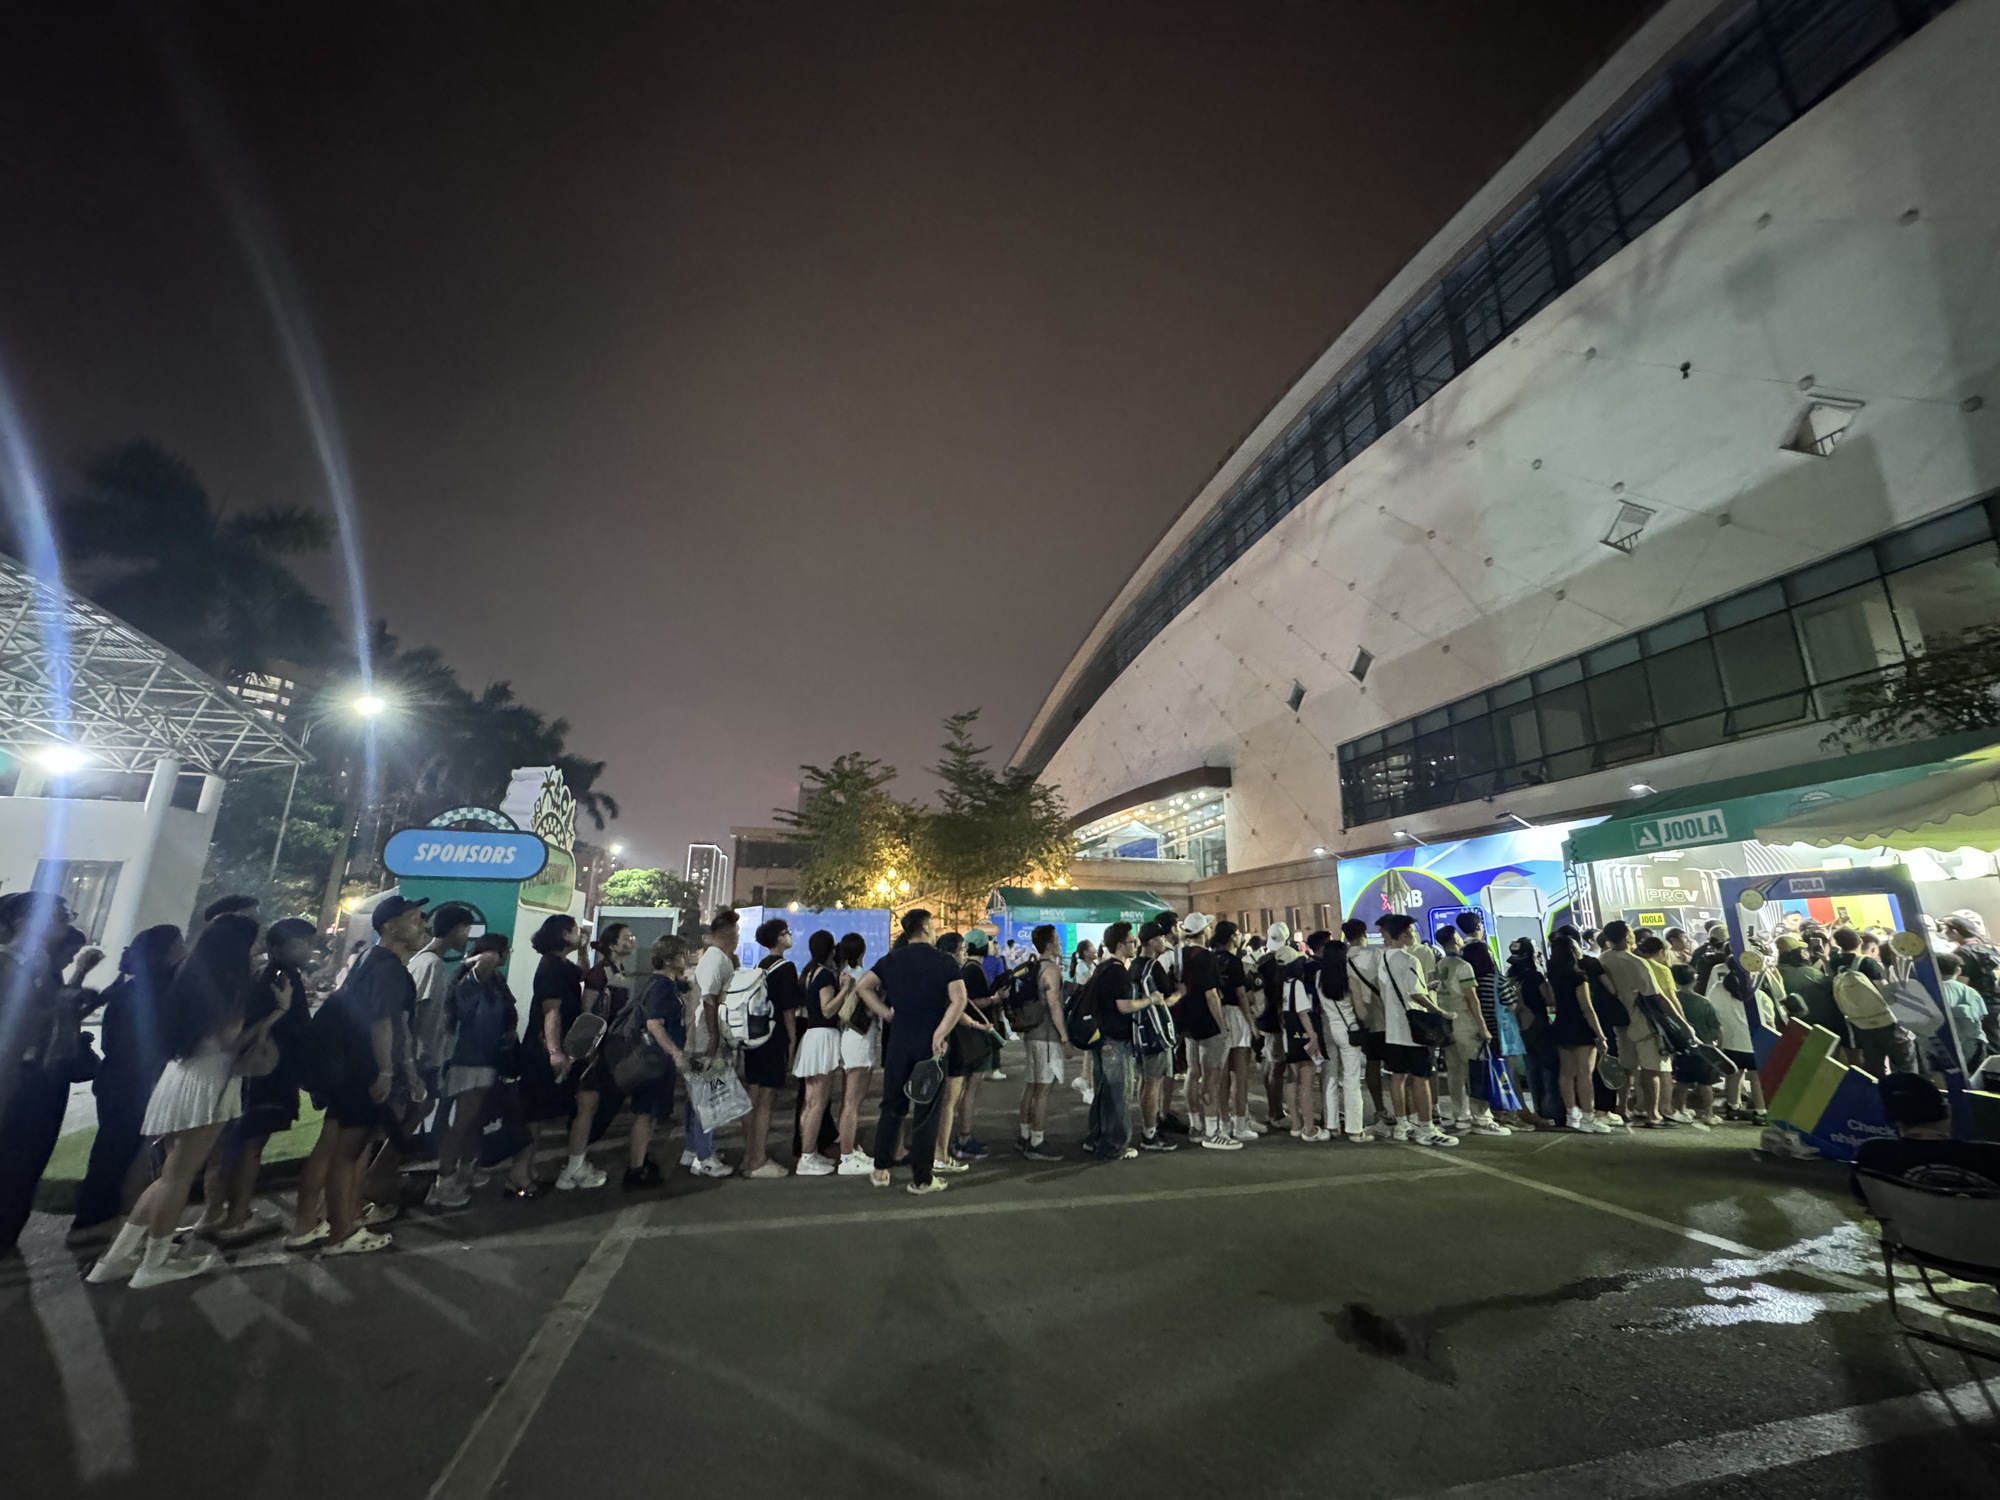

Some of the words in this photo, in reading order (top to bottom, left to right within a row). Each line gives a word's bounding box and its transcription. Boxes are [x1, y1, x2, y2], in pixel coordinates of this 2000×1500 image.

[1663, 814, 1724, 843] JOOLA
[413, 842, 518, 865] SPONSORS
[1791, 879, 1824, 891] JOOLA
[1641, 915, 1664, 924] JOOLA
[1847, 1118, 1898, 1138] Check
